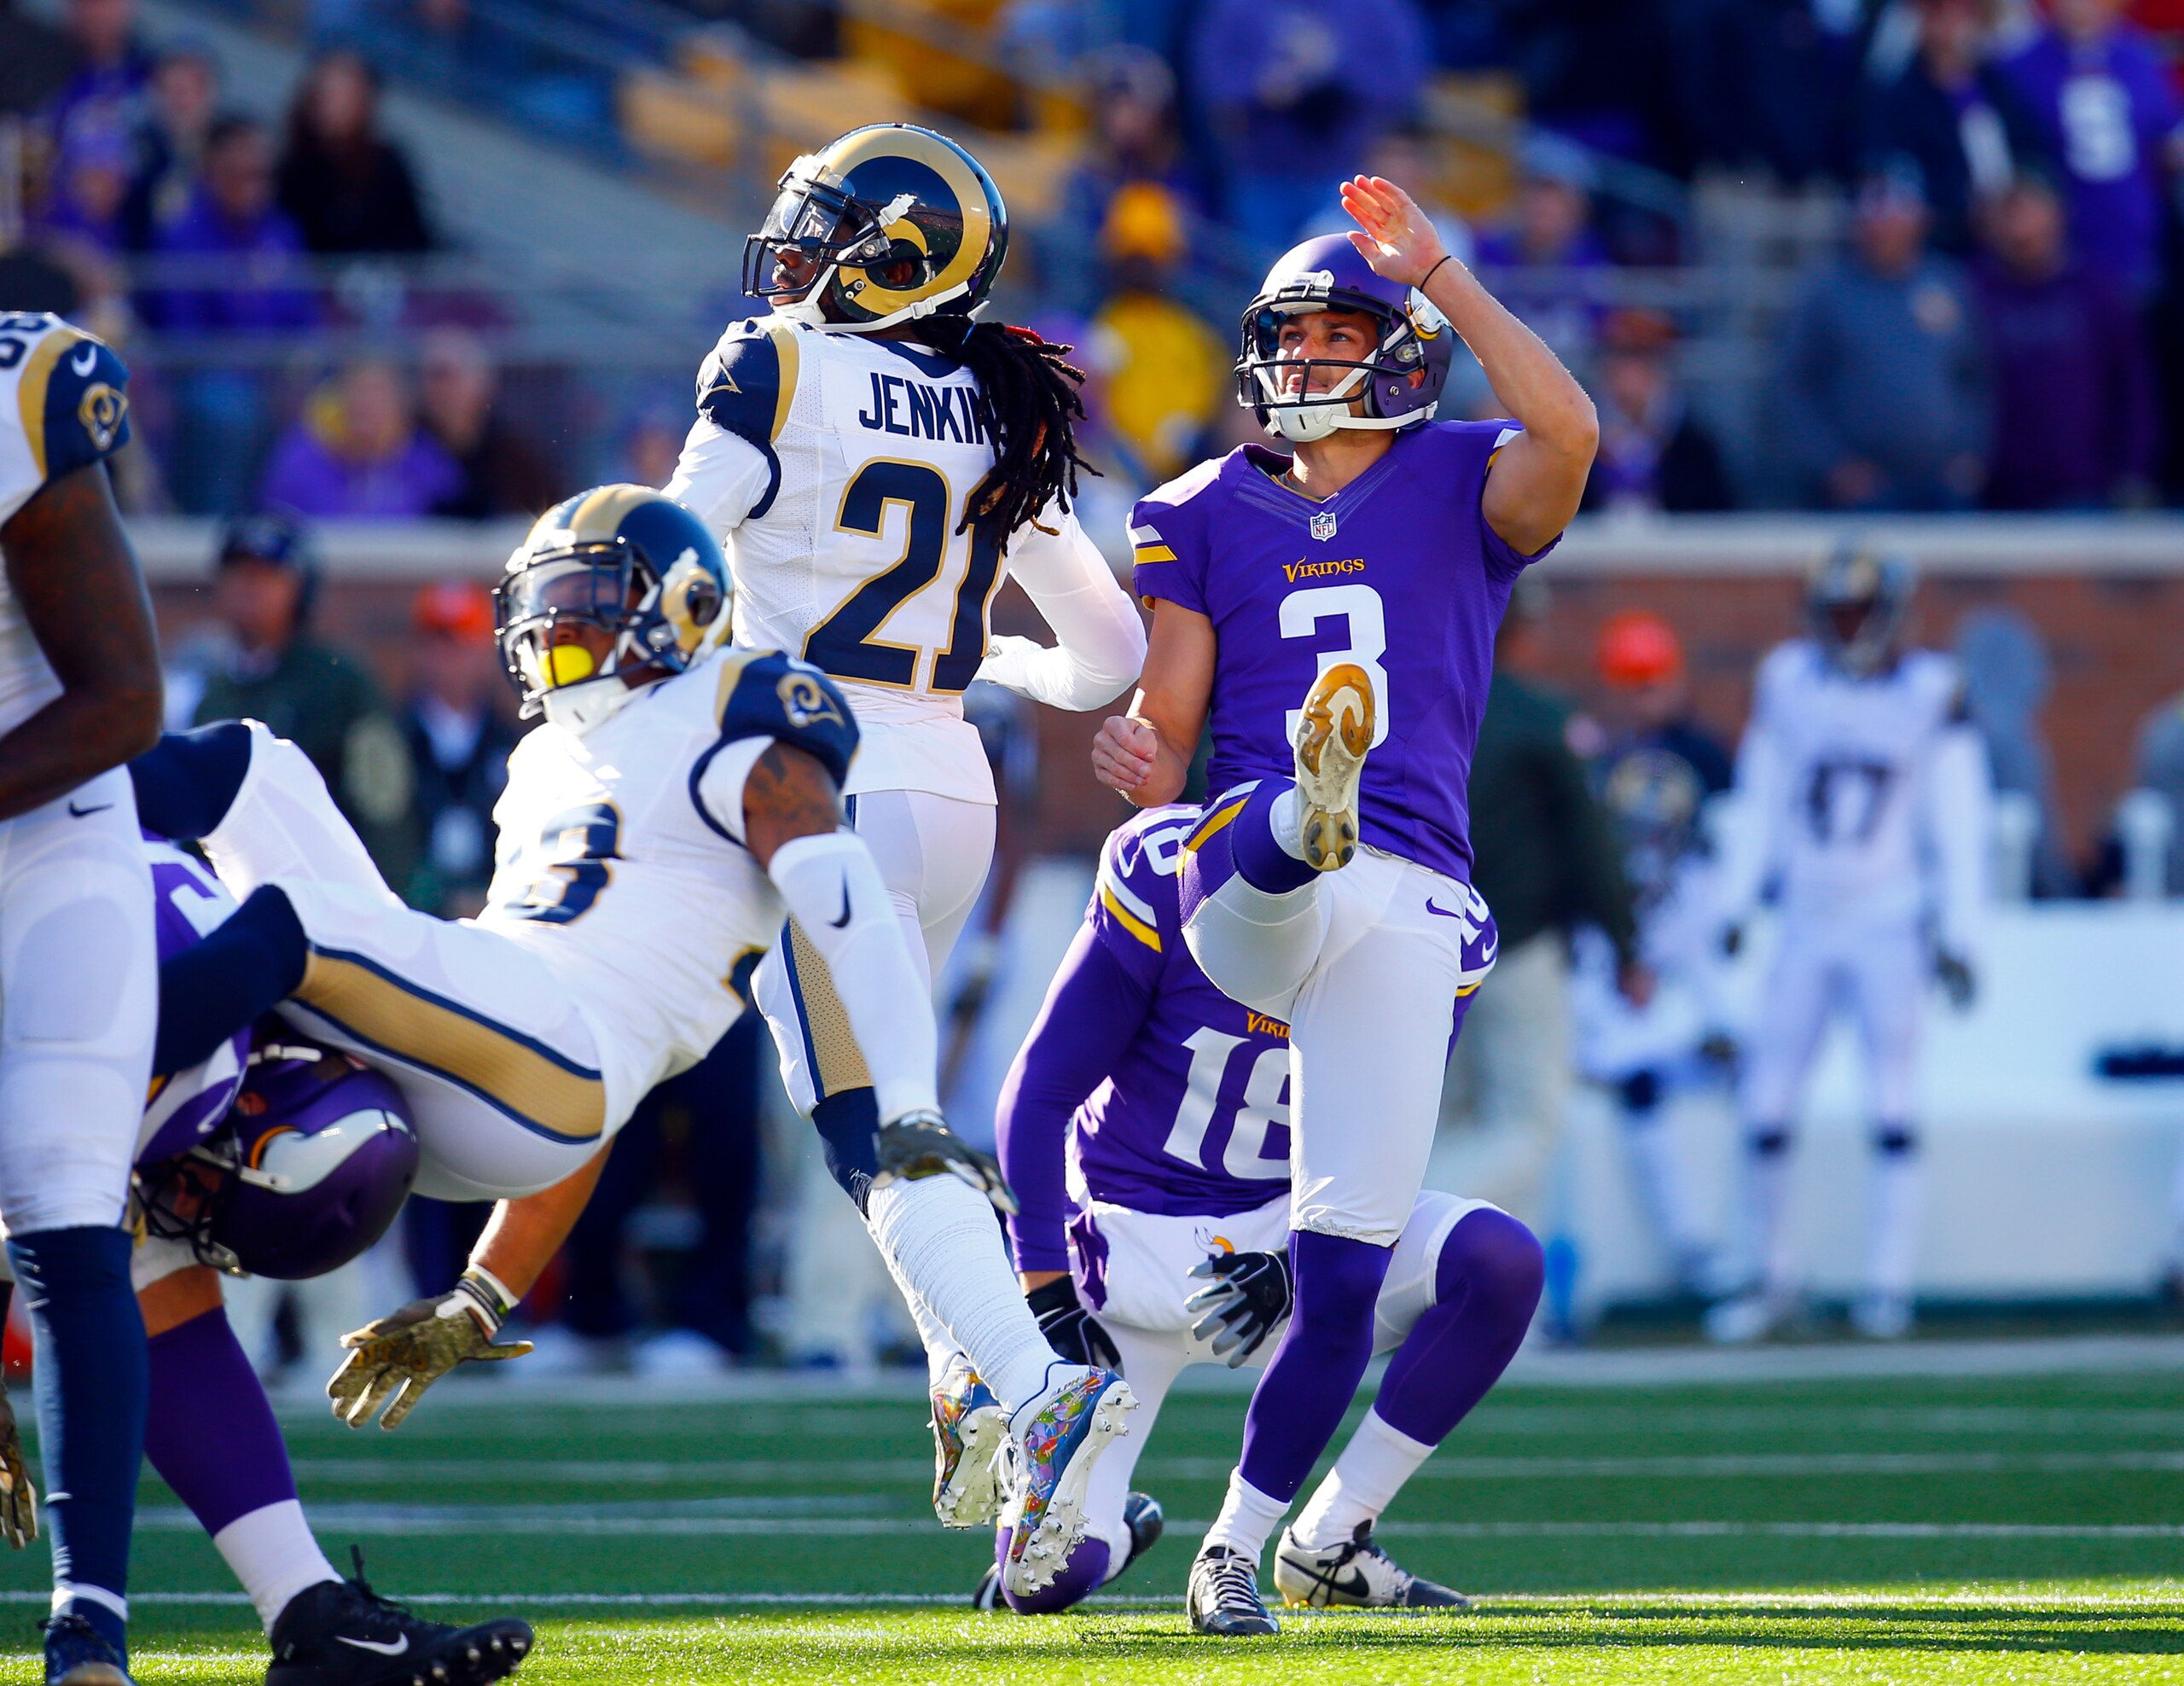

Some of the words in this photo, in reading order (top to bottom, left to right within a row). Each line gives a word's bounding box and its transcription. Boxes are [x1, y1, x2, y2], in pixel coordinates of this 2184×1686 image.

[859, 372, 1003, 449] JENKIN
[800, 456, 1003, 696] 21
[1315, 524, 1333, 536] NFL
[1279, 584, 1390, 751] 3
[1246, 1010, 1291, 1038] VIKI
[1163, 1026, 1291, 1180] 18
